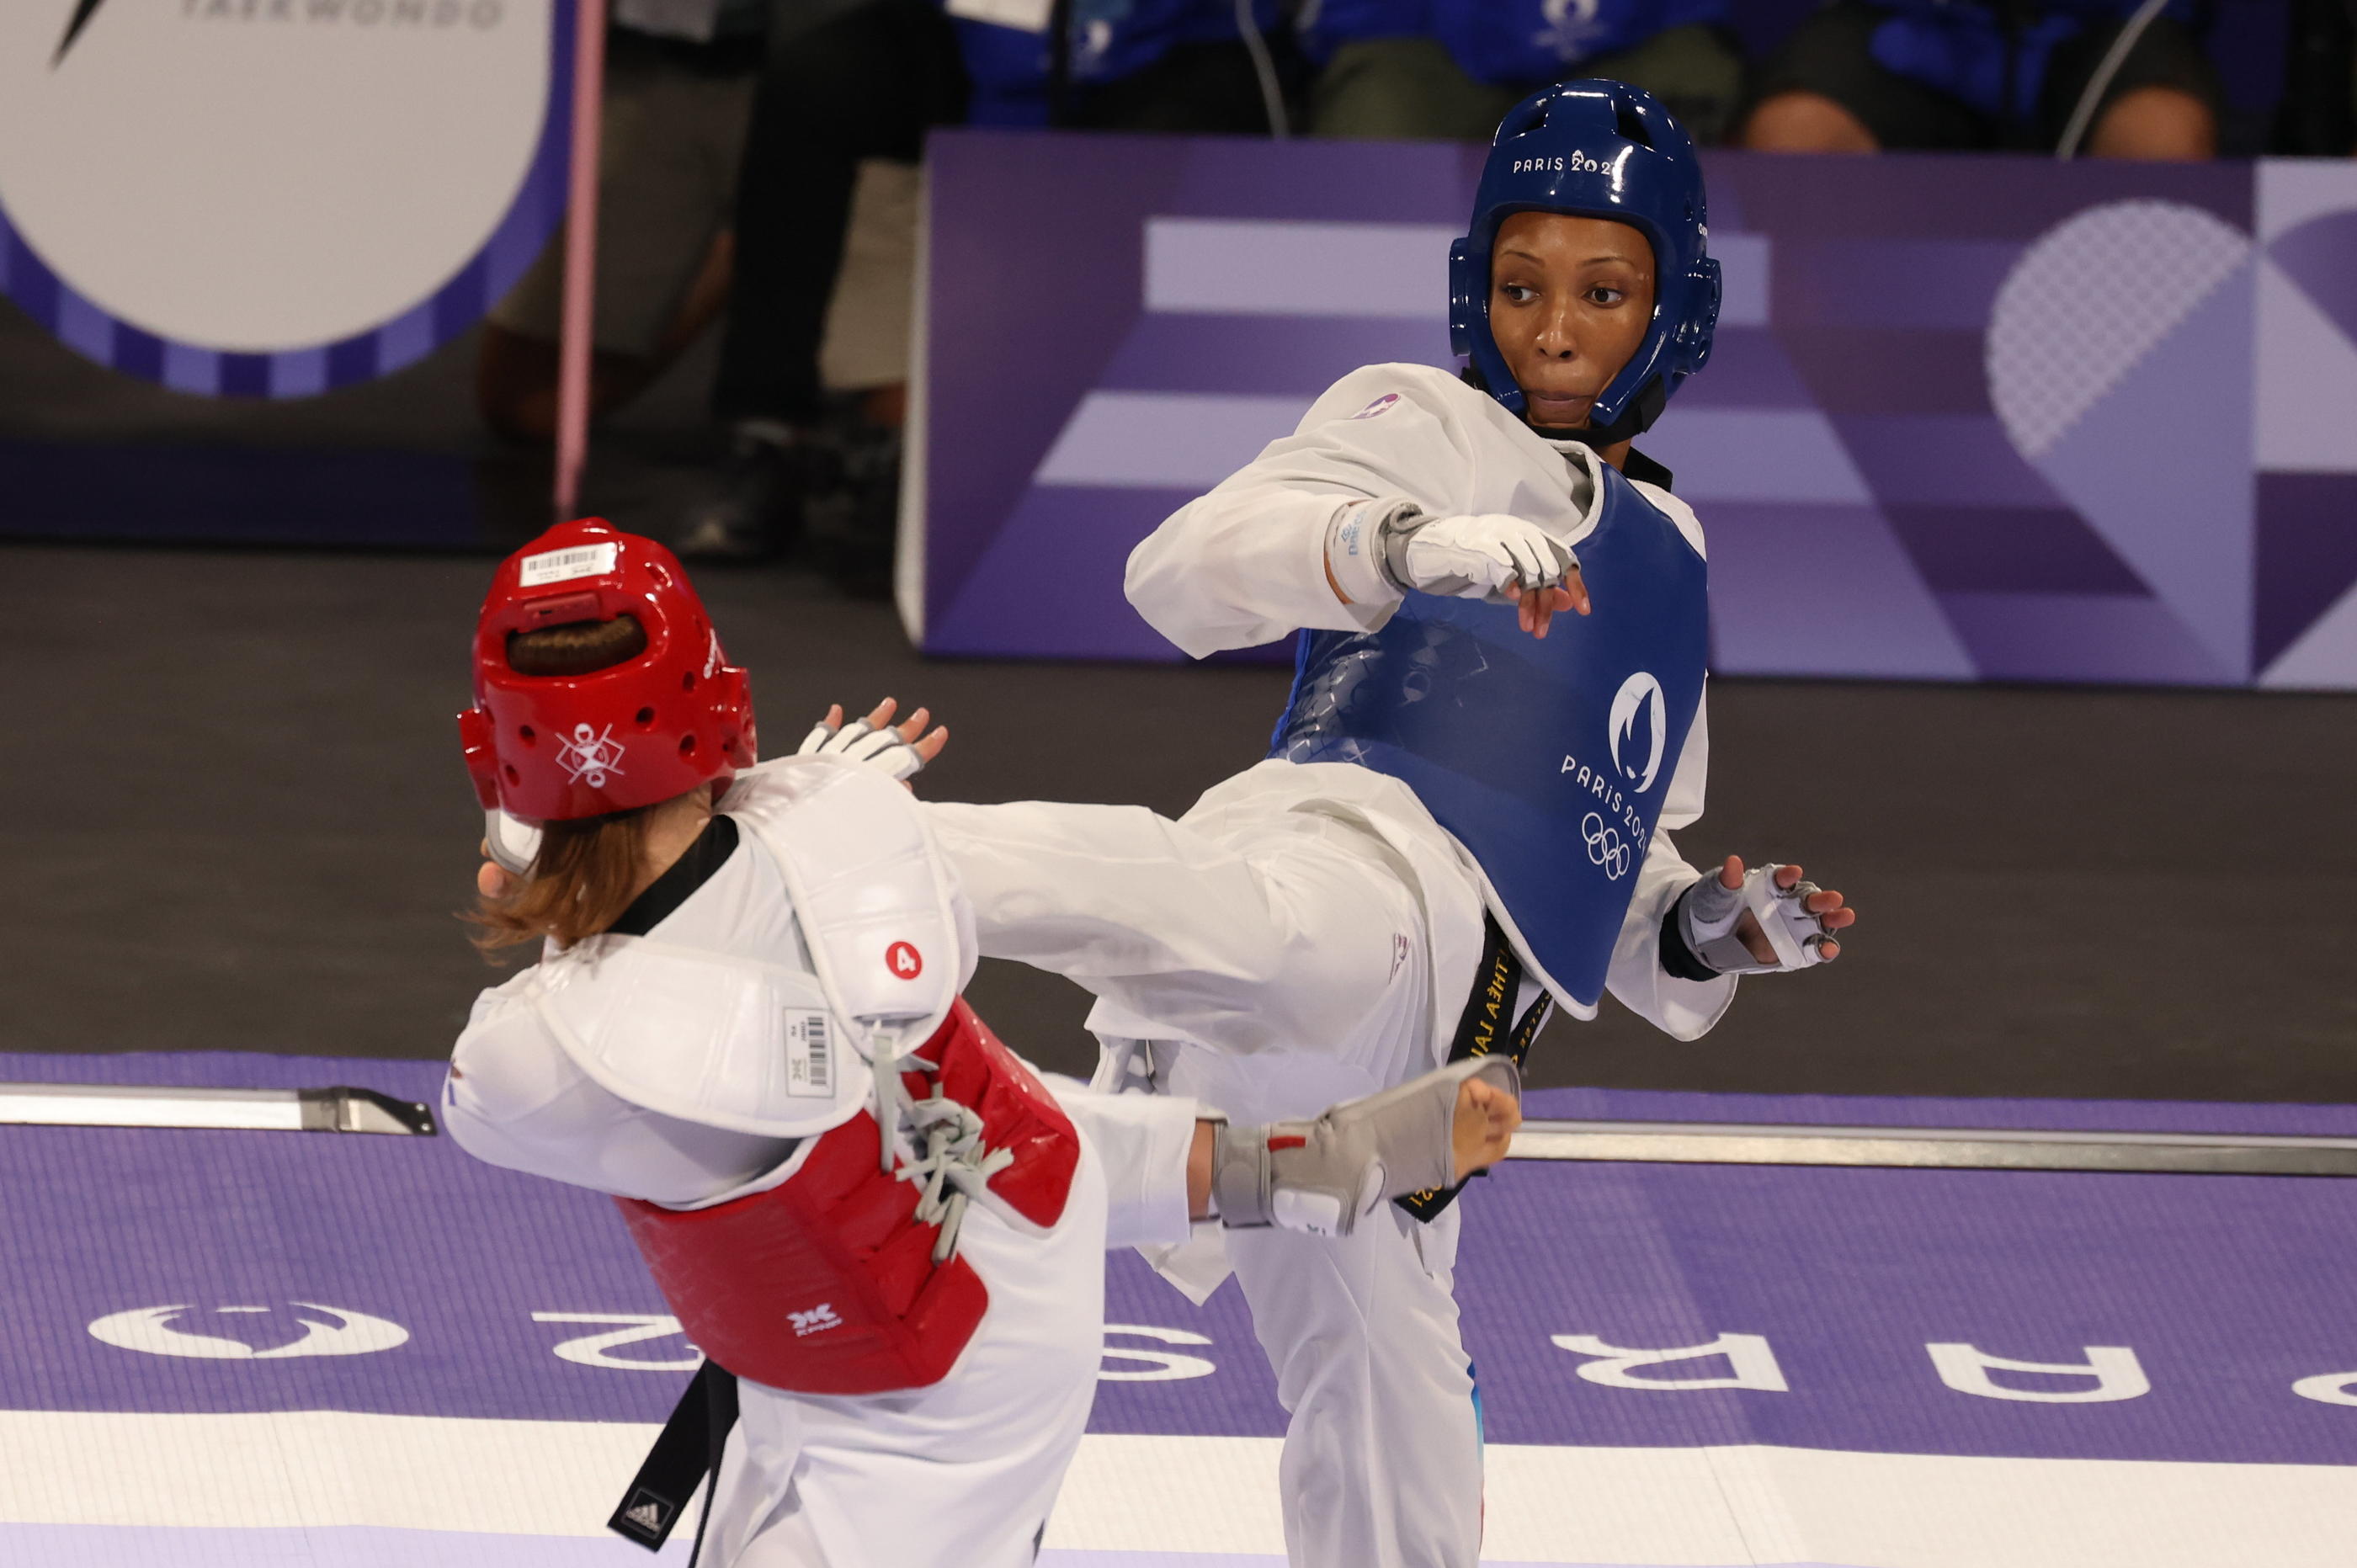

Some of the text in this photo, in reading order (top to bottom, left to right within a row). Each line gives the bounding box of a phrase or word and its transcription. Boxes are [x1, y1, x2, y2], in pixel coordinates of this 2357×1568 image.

[1513, 157, 1611, 175] PARIS 202
[1561, 754, 1647, 853] PARIS 202
[896, 945, 916, 972] 4
